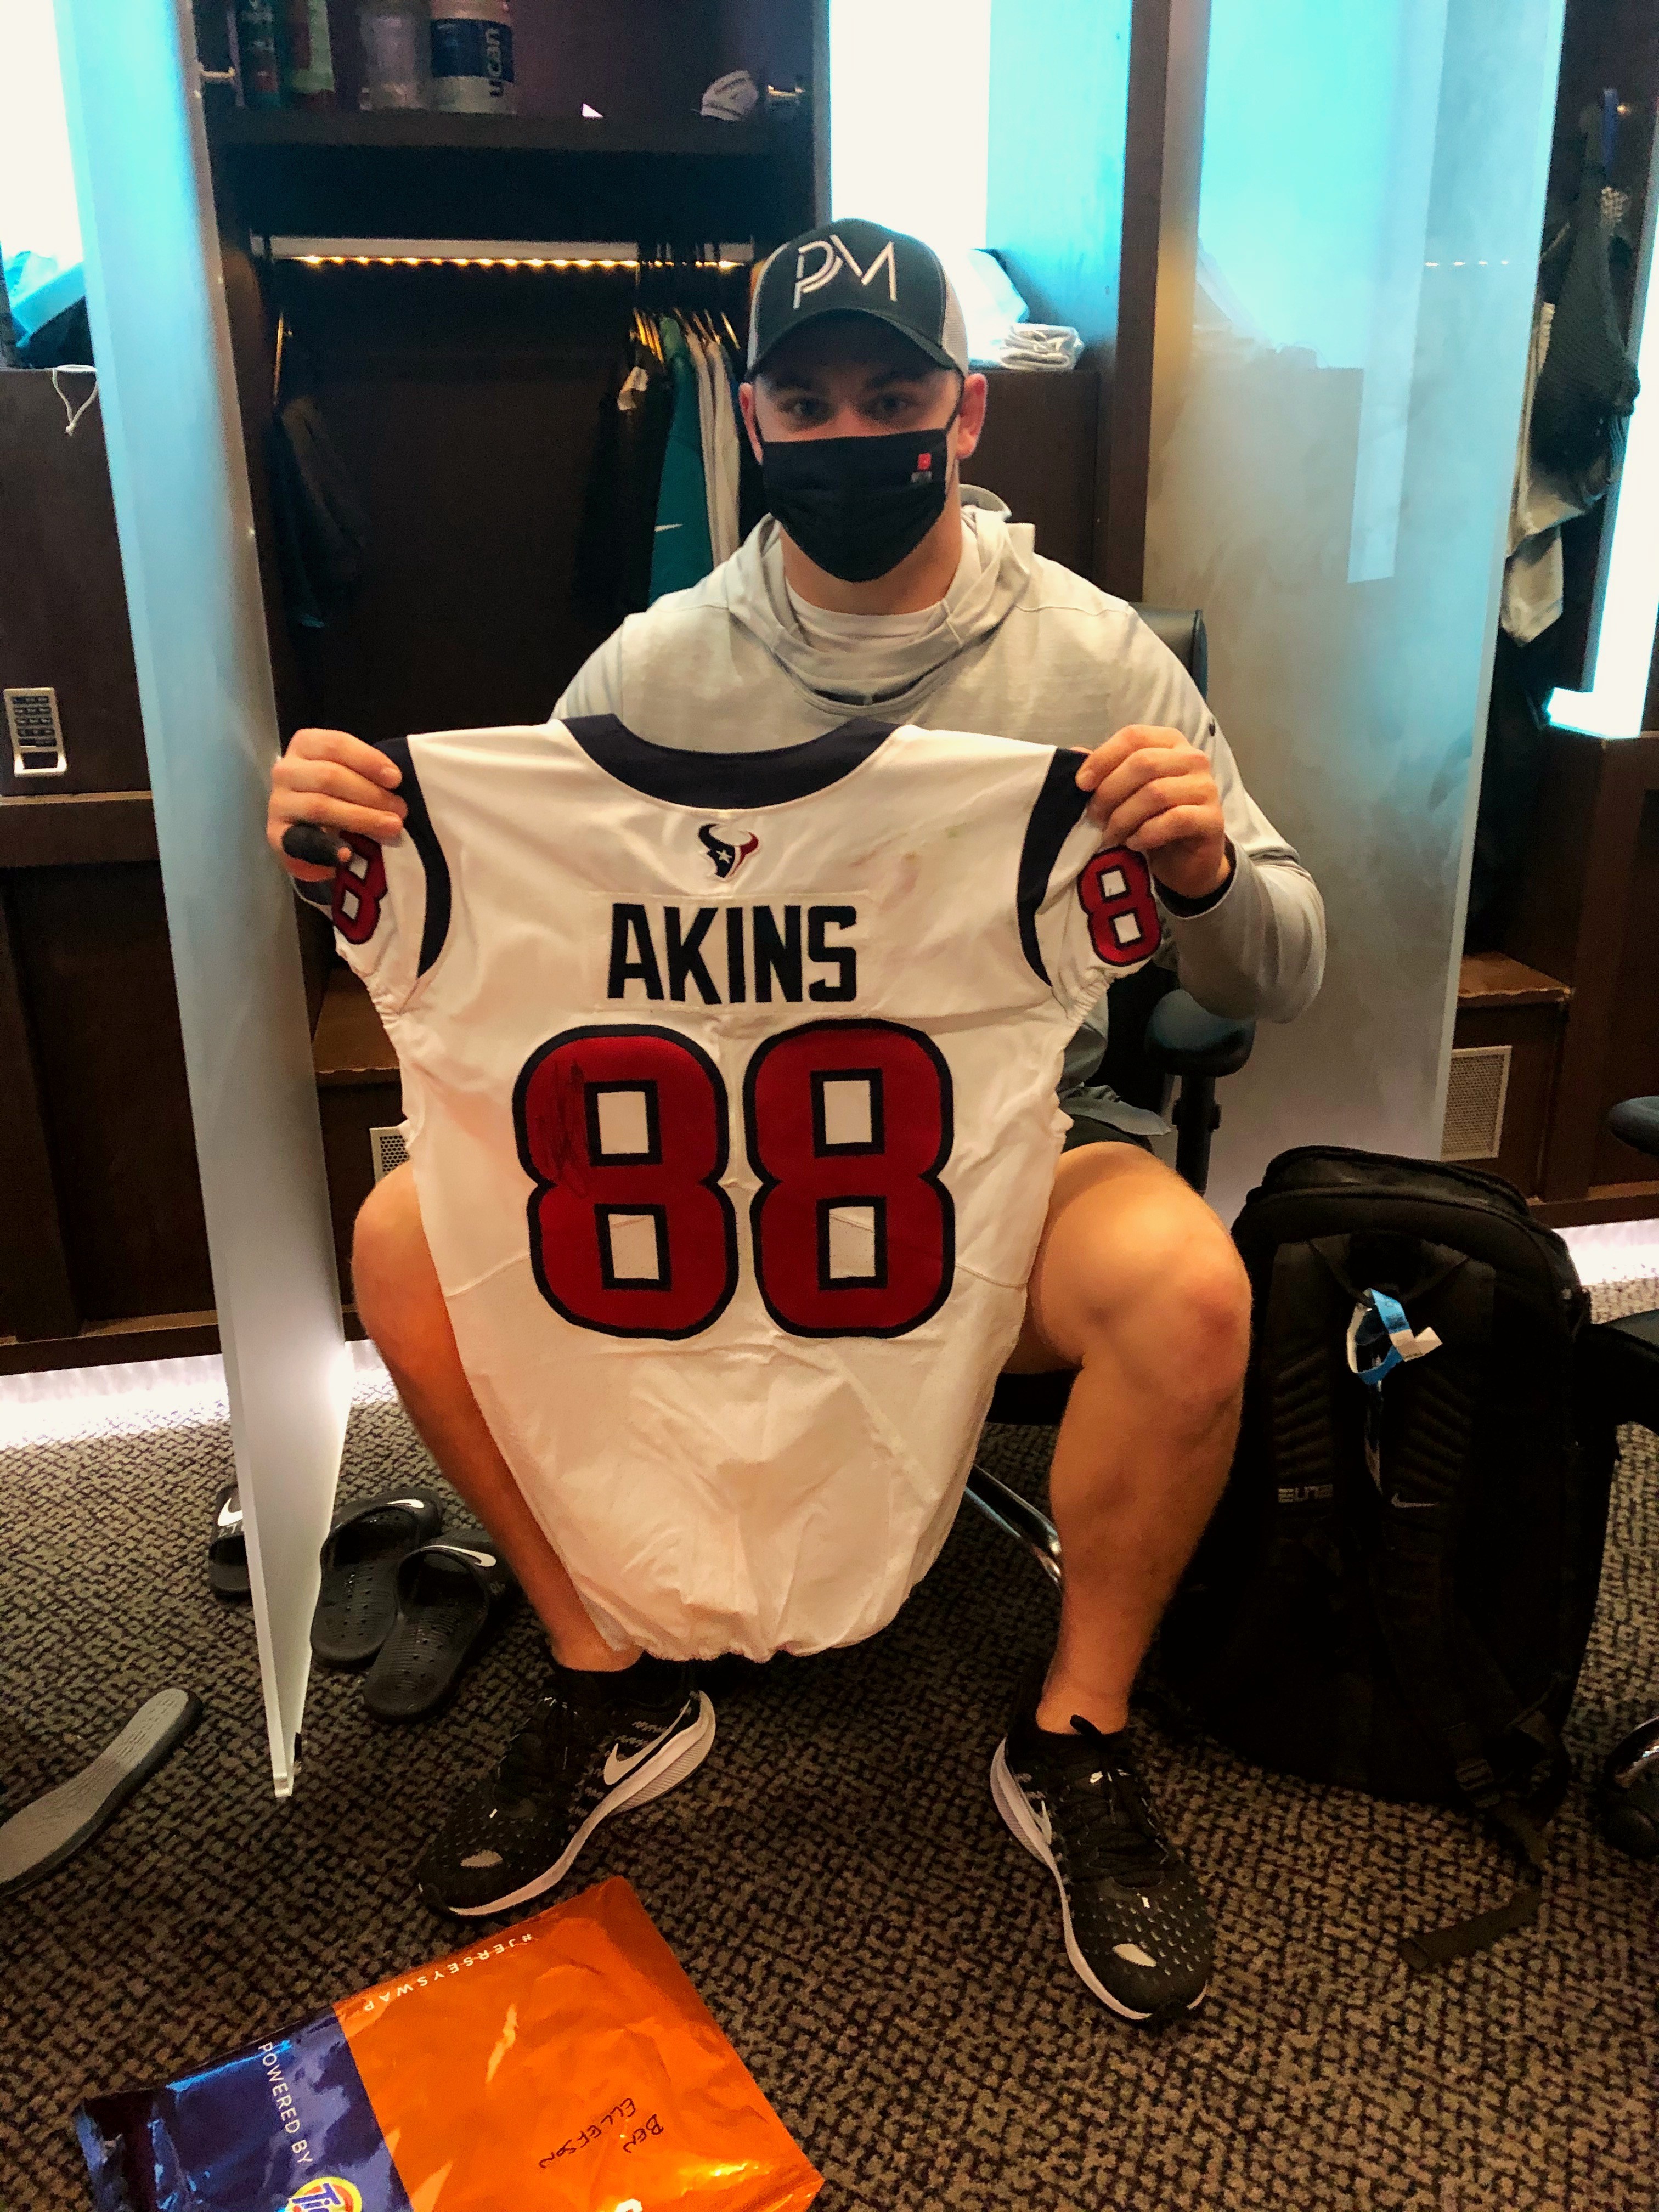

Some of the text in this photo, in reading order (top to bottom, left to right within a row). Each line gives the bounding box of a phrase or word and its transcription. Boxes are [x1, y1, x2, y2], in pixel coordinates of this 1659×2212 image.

[793, 234, 897, 309] PM
[1076, 843, 1162, 967] 8
[607, 902, 857, 1005] AKINS
[512, 1018, 956, 1340] 88
[364, 1933, 532, 2011] #JERSEYSWAP
[258, 2042, 313, 2163] POWERED BY
[538, 2097, 636, 2168] ELLEFSON
[623, 2113, 664, 2153] BEN
